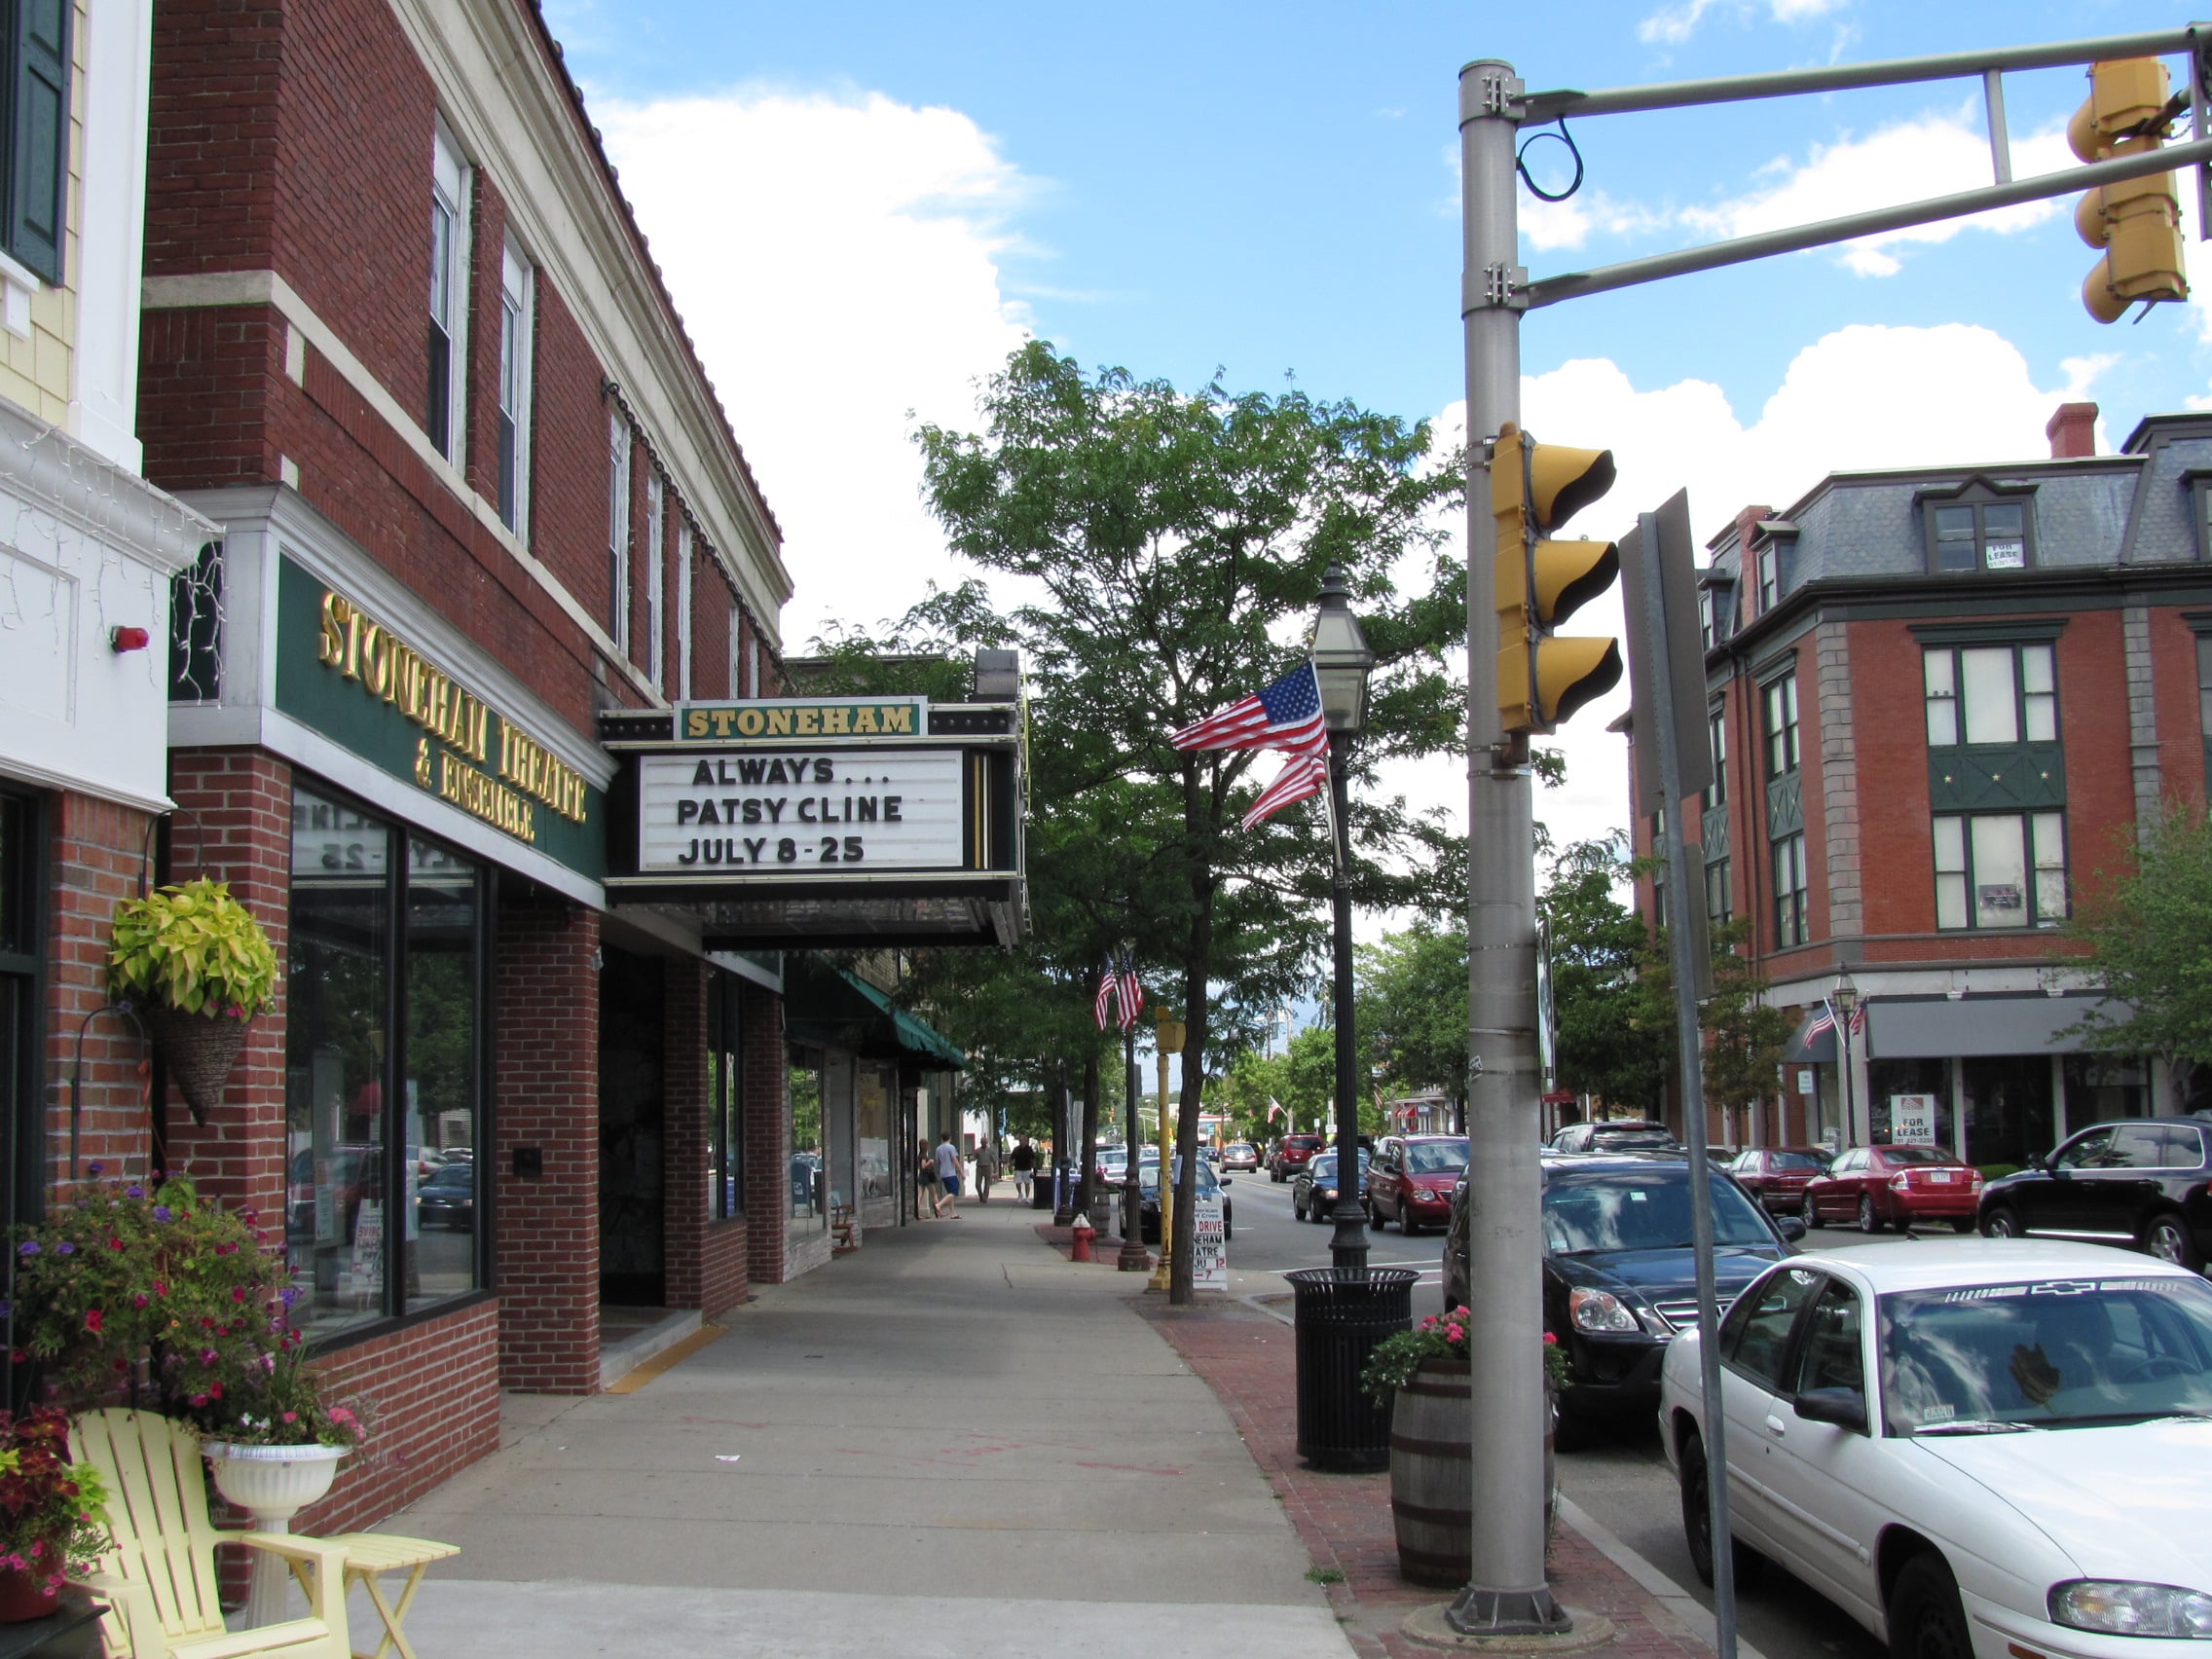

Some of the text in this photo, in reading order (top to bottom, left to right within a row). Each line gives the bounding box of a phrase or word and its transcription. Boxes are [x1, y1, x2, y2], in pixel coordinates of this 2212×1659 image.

[1988, 551, 2017, 561] LEASE
[319, 592, 586, 825] STONEHAM THEATRE
[688, 707, 912, 736] STONEHAM
[416, 738, 535, 845] & ENSEMBLE
[678, 795, 903, 825] PATSY CLINE
[679, 837, 767, 865] JULY
[1199, 1221, 1222, 1232] DRIVE
